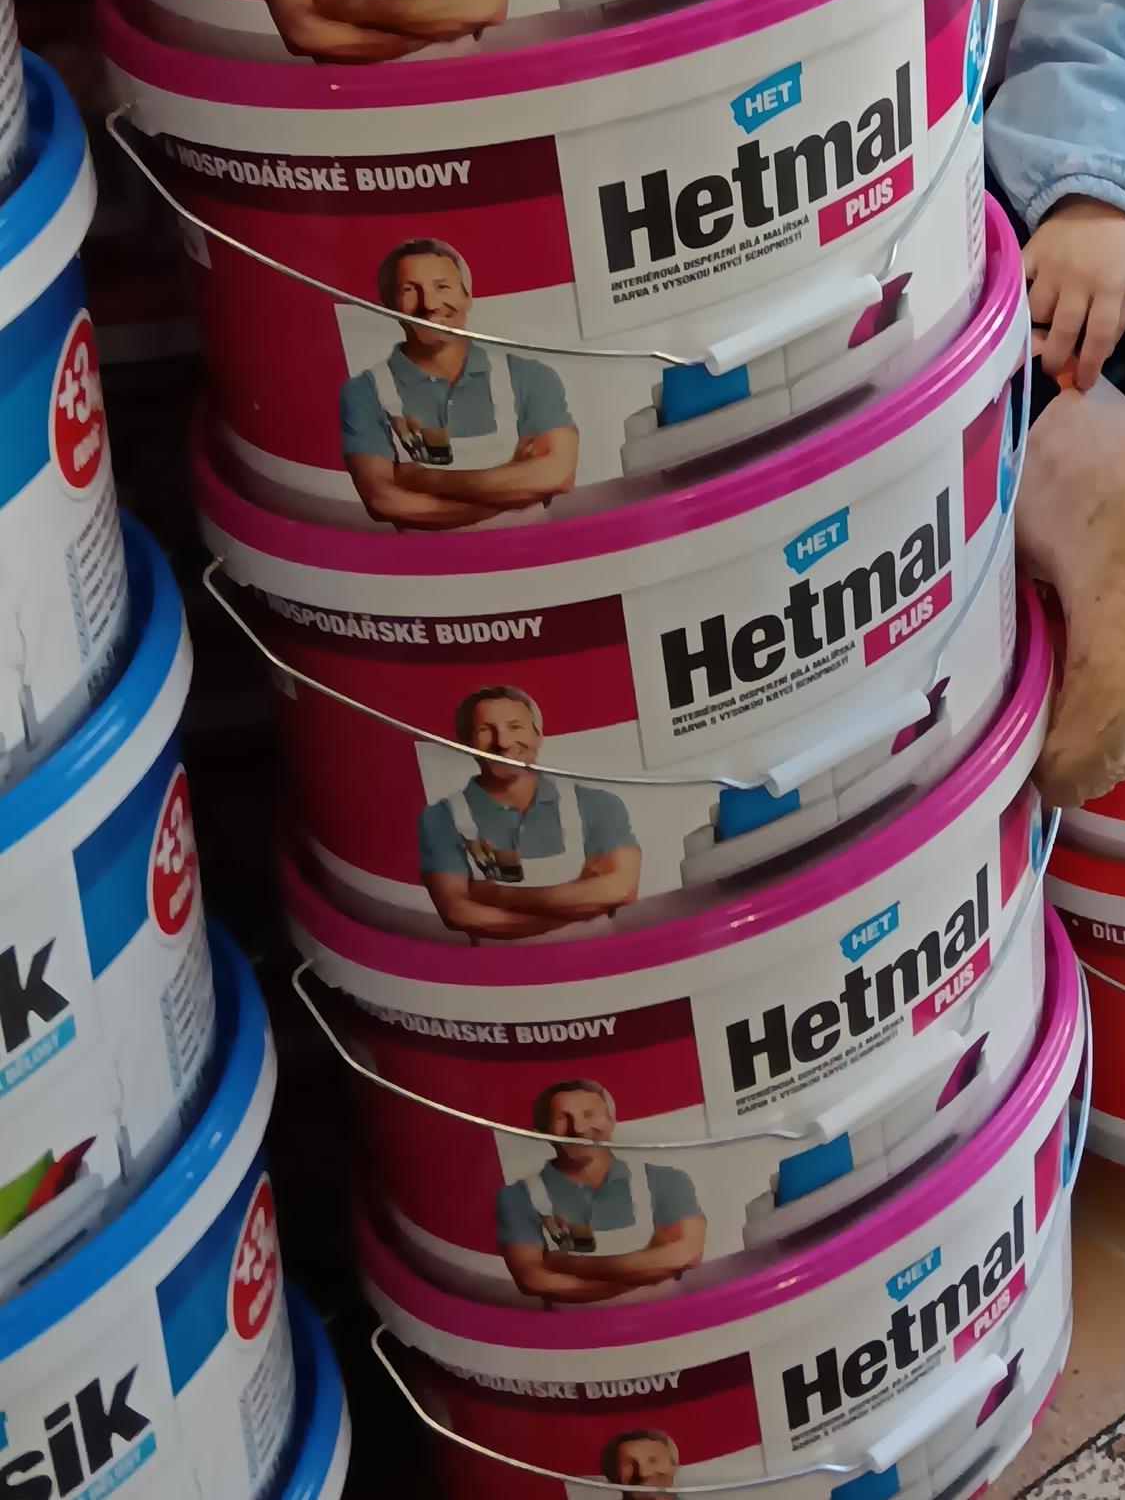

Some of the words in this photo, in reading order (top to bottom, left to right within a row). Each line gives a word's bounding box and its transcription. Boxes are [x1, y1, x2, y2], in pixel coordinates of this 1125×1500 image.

[745, 80, 792, 118] HET
[177, 140, 349, 191] HOSPODÁŘSKÉ
[356, 160, 471, 191] BUDOVY
[599, 61, 912, 273] Hetmal
[846, 177, 893, 225] PLUS
[653, 284, 659, 293] S
[797, 522, 840, 559] HET
[660, 486, 951, 710] Hetmal
[889, 596, 933, 644] PLUS
[435, 616, 543, 644] BUDOVY
[851, 912, 891, 949] HET
[726, 863, 989, 1092] Hetmal
[934, 963, 974, 1014] PLUS
[515, 1017, 617, 1044] BUDOVY
[897, 1252, 936, 1291] HET
[782, 1195, 1024, 1430] Hetmal
[974, 1288, 1011, 1339] PLUS
[0, 1364, 151, 1500] sik
